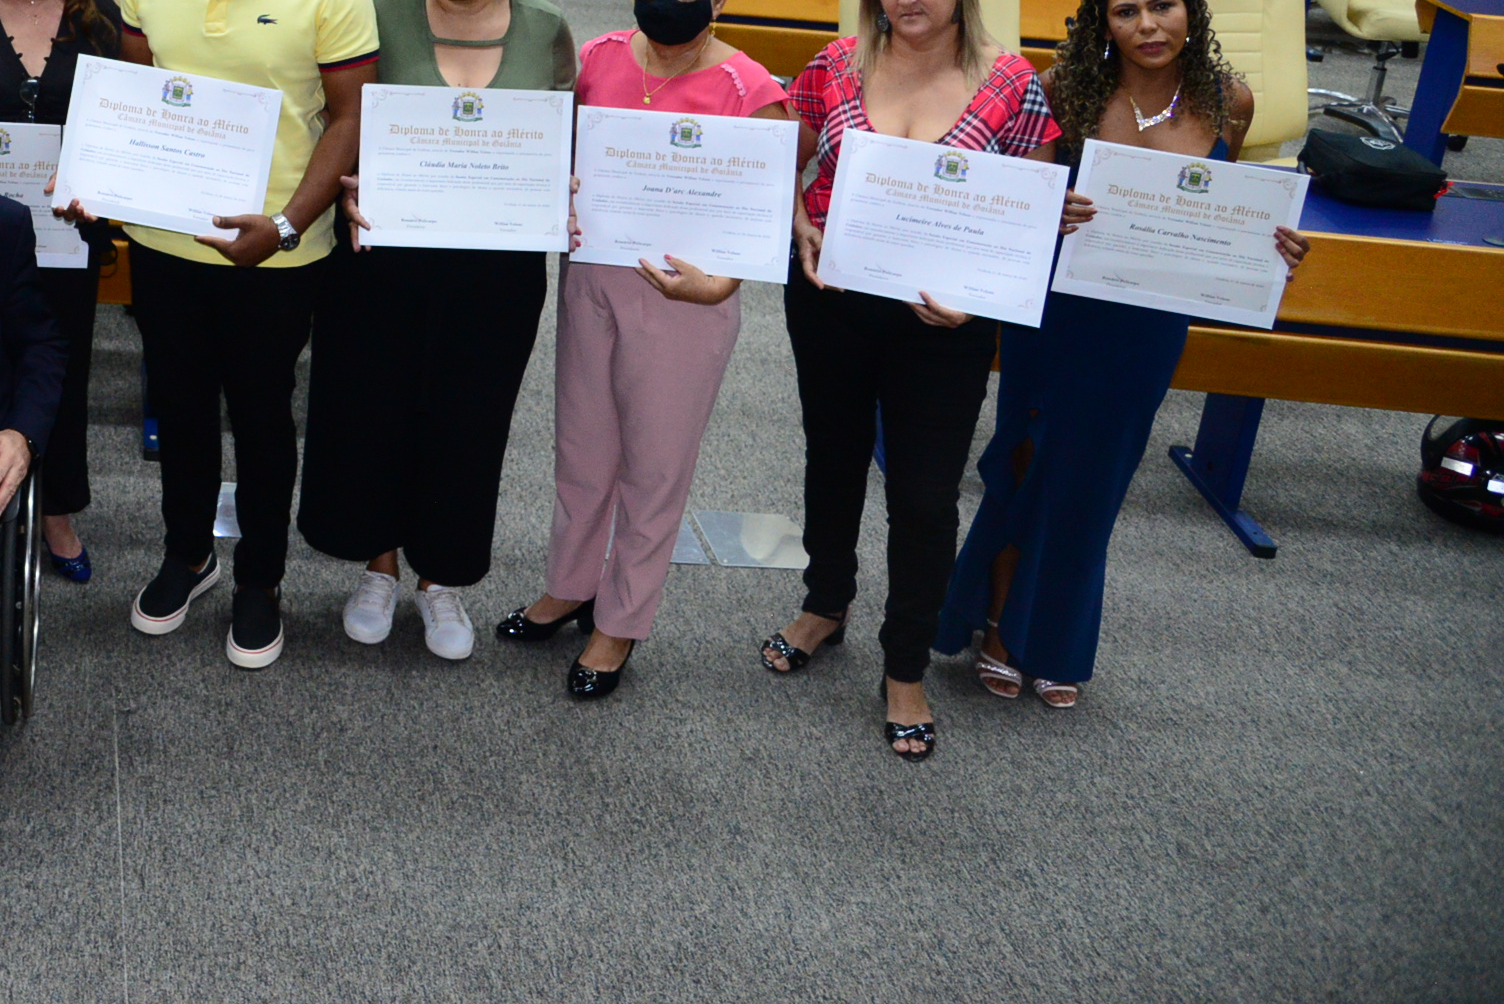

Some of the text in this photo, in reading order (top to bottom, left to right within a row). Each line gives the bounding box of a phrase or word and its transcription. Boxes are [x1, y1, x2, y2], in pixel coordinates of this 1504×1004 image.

[99, 98, 249, 134] Diploma de Honra ao Mérito
[118, 113, 226, 139] Câmara Municipal de Goiânia
[389, 124, 544, 139] Diploma de Honra ao Mérito
[129, 139, 205, 158] Hallisson Santos Castro
[410, 137, 440, 145] Câmara
[442, 138, 480, 147] Municipal
[492, 139, 522, 148] Goiânia
[33, 161, 58, 171] Mér
[419, 160, 446, 168] Cláudia
[447, 161, 468, 169] Maria
[605, 147, 766, 169] Diploma de Honra ao Mérito
[626, 160, 657, 169] Câmara
[659, 163, 698, 173] Municipal
[711, 167, 742, 177] Goiânia
[19, 170, 47, 178] Goiânia
[642, 185, 663, 193] Joana
[688, 188, 722, 197] Alexandre
[865, 173, 1031, 211] Diploma de Honra ao Mérito
[886, 189, 1005, 216] Câmara Municipal de Goiânia
[1107, 184, 1271, 220] Diploma de Honra ao Mérito
[1127, 199, 1245, 226] Câmara Municipal de Goiânia
[896, 214, 932, 227] Lucimeire
[932, 220, 952, 230] Alves
[963, 226, 984, 235] Paula
[1129, 223, 1231, 246] Rosália Carvalho Nascimento
